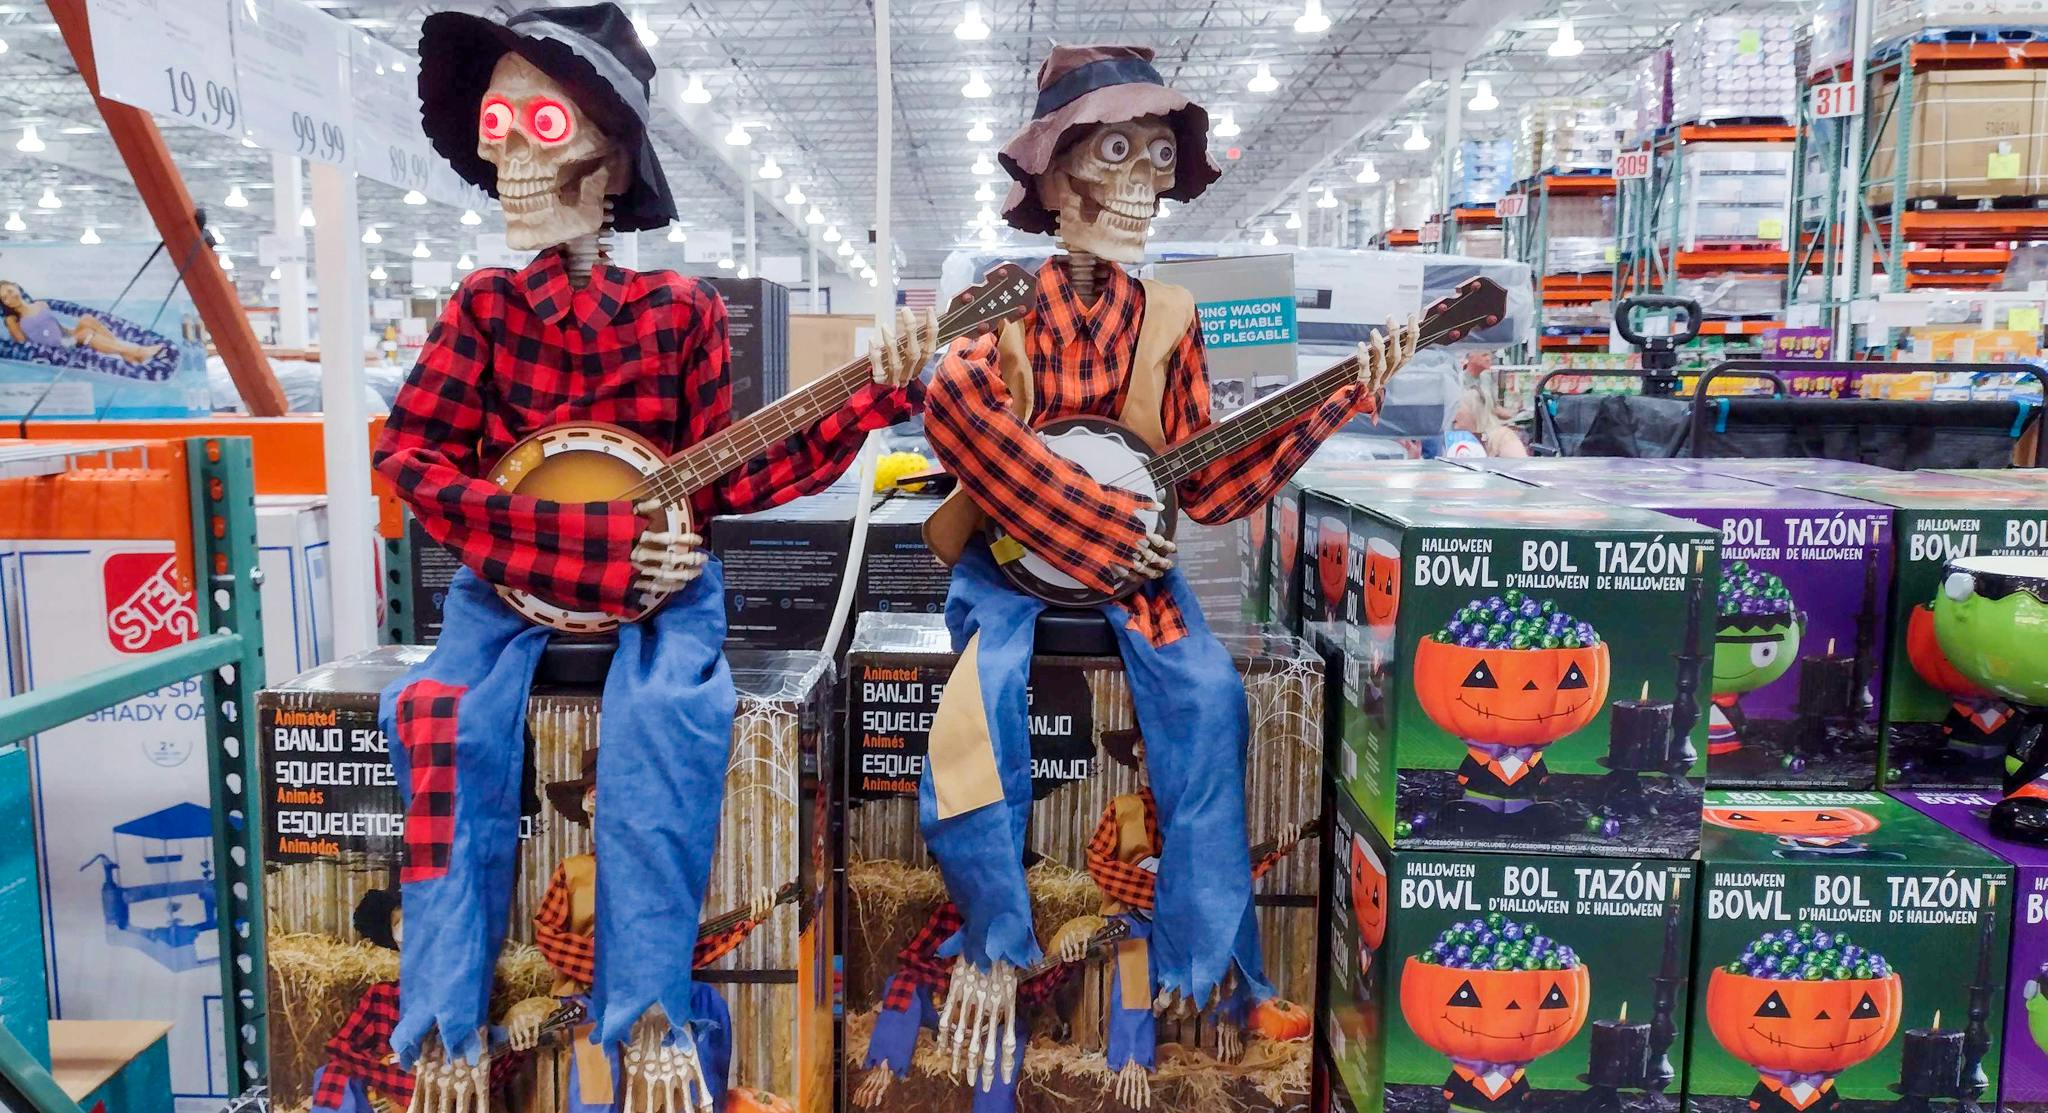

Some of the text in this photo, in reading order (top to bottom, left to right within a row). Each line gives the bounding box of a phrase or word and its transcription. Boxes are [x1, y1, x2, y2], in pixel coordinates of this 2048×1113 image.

[165, 67, 236, 130] 19.99
[1817, 88, 1856, 115] 311
[291, 111, 345, 164] 99.99
[389, 145, 428, 190] 89.99
[1616, 154, 1648, 176] 309
[1499, 198, 1524, 216] 307
[1230, 302, 1281, 316] WAGON
[1229, 316, 1283, 330] PLIABLE
[1223, 329, 1290, 343] PLEGABLE
[1722, 517, 1770, 547] BOL
[1785, 511, 1867, 547] TAZÓN
[1917, 519, 1980, 532] HALLOWEEN
[1422, 538, 1493, 553] HALLOWEEN
[1595, 534, 1689, 575] TAZÓN
[1786, 547, 1863, 561] DE HALLOWEEN
[1522, 540, 1578, 573] BOL
[1415, 555, 1498, 588] BOWL
[1506, 574, 1589, 590] D'HALLOWEEN
[1597, 576, 1685, 591] DE HALLOWEEN
[1347, 589, 1359, 626] BOL
[863, 665, 918, 682] Animated
[863, 683, 923, 703] BANJO
[274, 708, 337, 727] Animated
[274, 728, 343, 753] BANJO
[863, 733, 905, 749] Animés
[276, 761, 398, 789] SQUELETTES
[1030, 759, 1088, 780] BANJO
[863, 777, 918, 793] Animados
[277, 786, 324, 805] Animés
[1726, 792, 1778, 801] BOL
[1917, 795, 2000, 806] BOWL
[277, 810, 404, 838] ESQUELETOS
[279, 836, 340, 857] Animados
[1406, 862, 1476, 878] HALLOWEEN
[1715, 872, 1785, 888] HALLOWEEN
[1504, 866, 1558, 898] BOL
[1574, 862, 1666, 901] TAZÓN
[1814, 875, 1870, 907] BOL
[1886, 870, 1982, 909] TAZÓN
[1400, 878, 1482, 911] BOWL
[1489, 897, 1569, 914] D'HALLOWEEN
[1577, 901, 1663, 917] DE HALLOWEEN
[1708, 889, 1791, 921] BOWL
[1799, 907, 1882, 923] D'HALLOWEEN
[2027, 893, 2048, 924] B
[1889, 910, 1978, 925] DE HALLOWEEN
